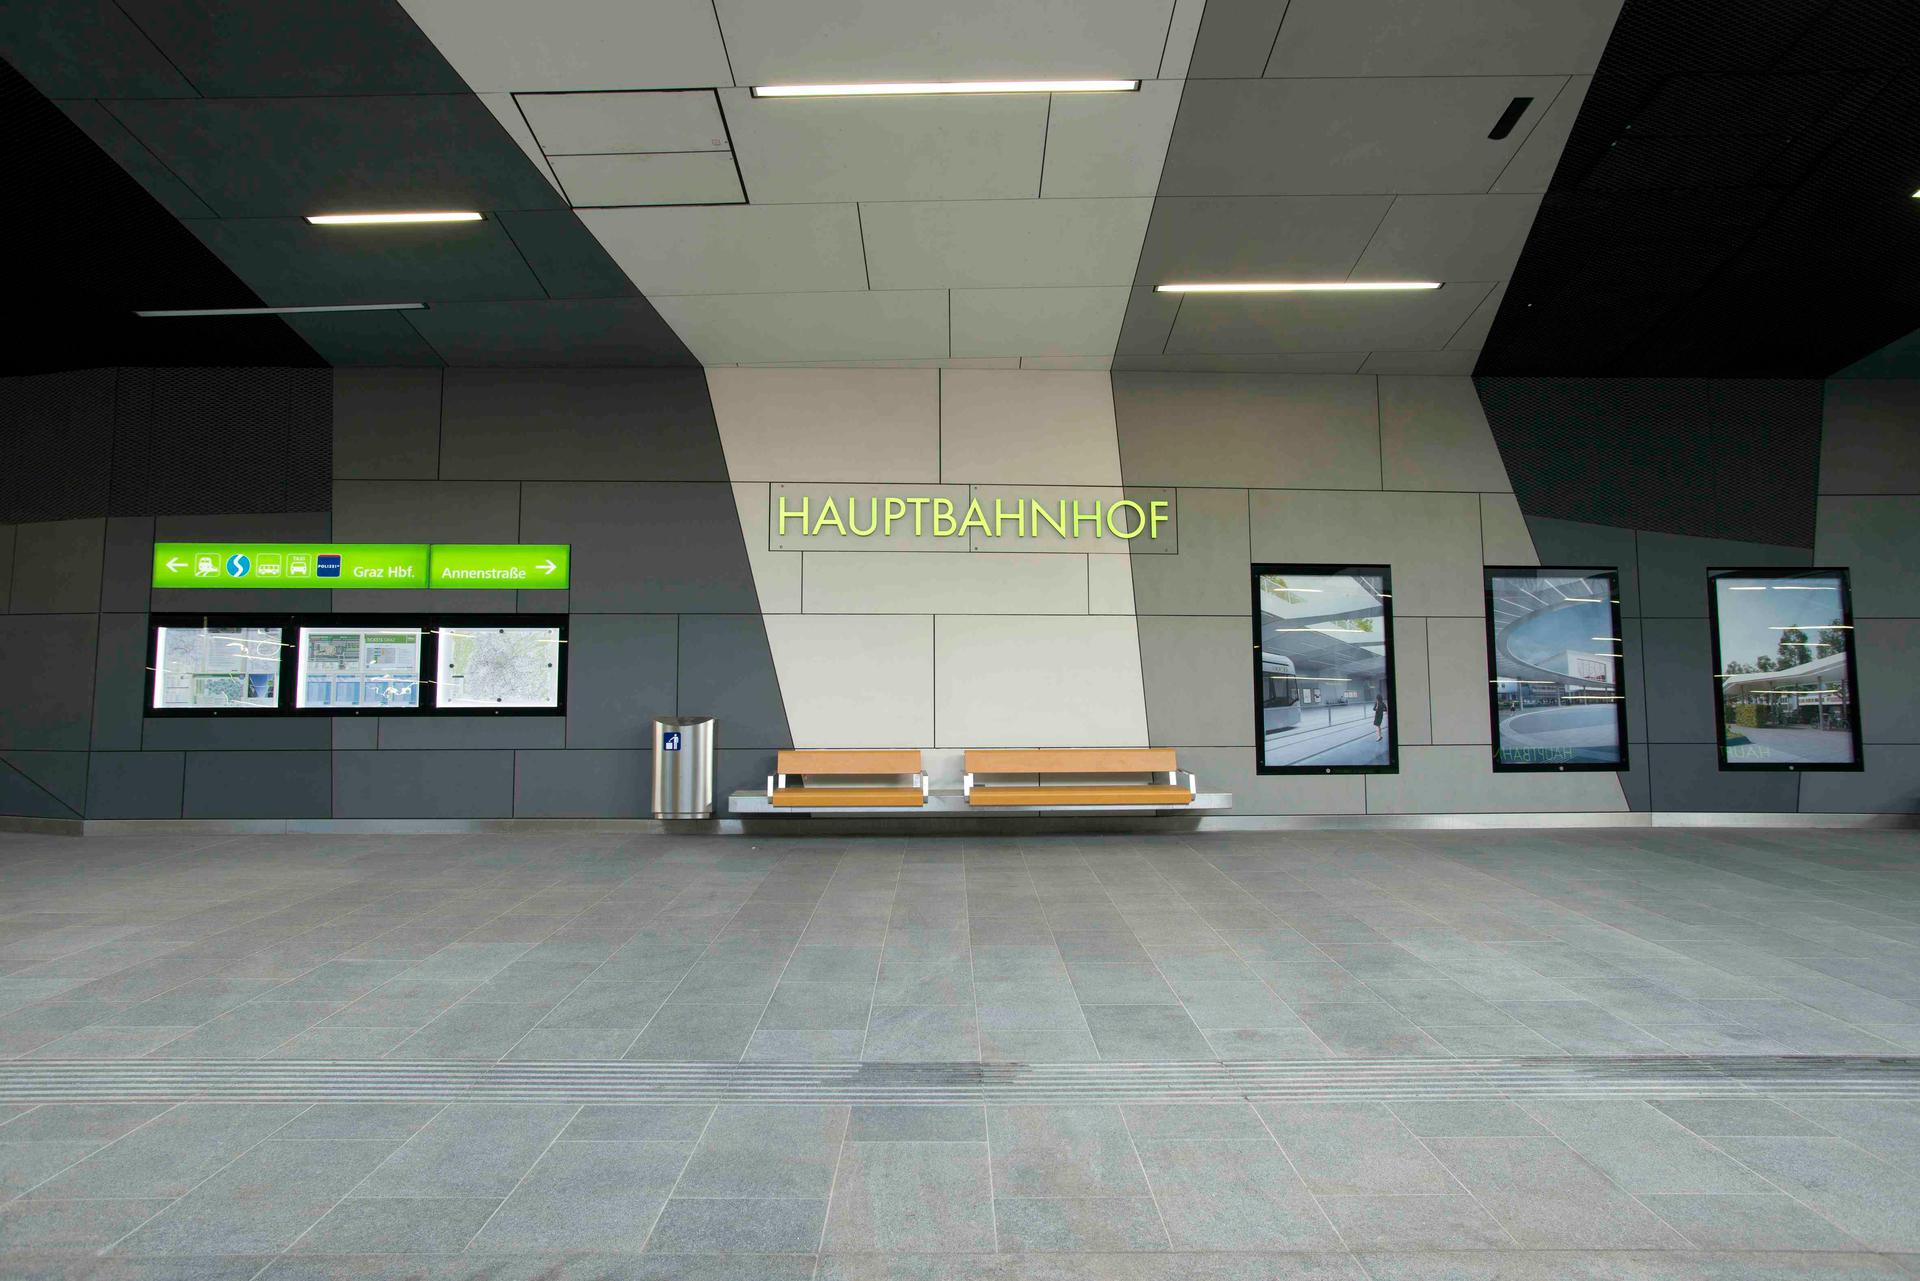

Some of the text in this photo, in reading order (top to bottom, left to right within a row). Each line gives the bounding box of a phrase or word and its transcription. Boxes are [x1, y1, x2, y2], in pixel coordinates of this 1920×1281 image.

[778, 495, 1169, 539] HAUPTBAHNHOF
[353, 566, 415, 578] Graz Hbf.
[441, 567, 526, 579] Annenstraße
